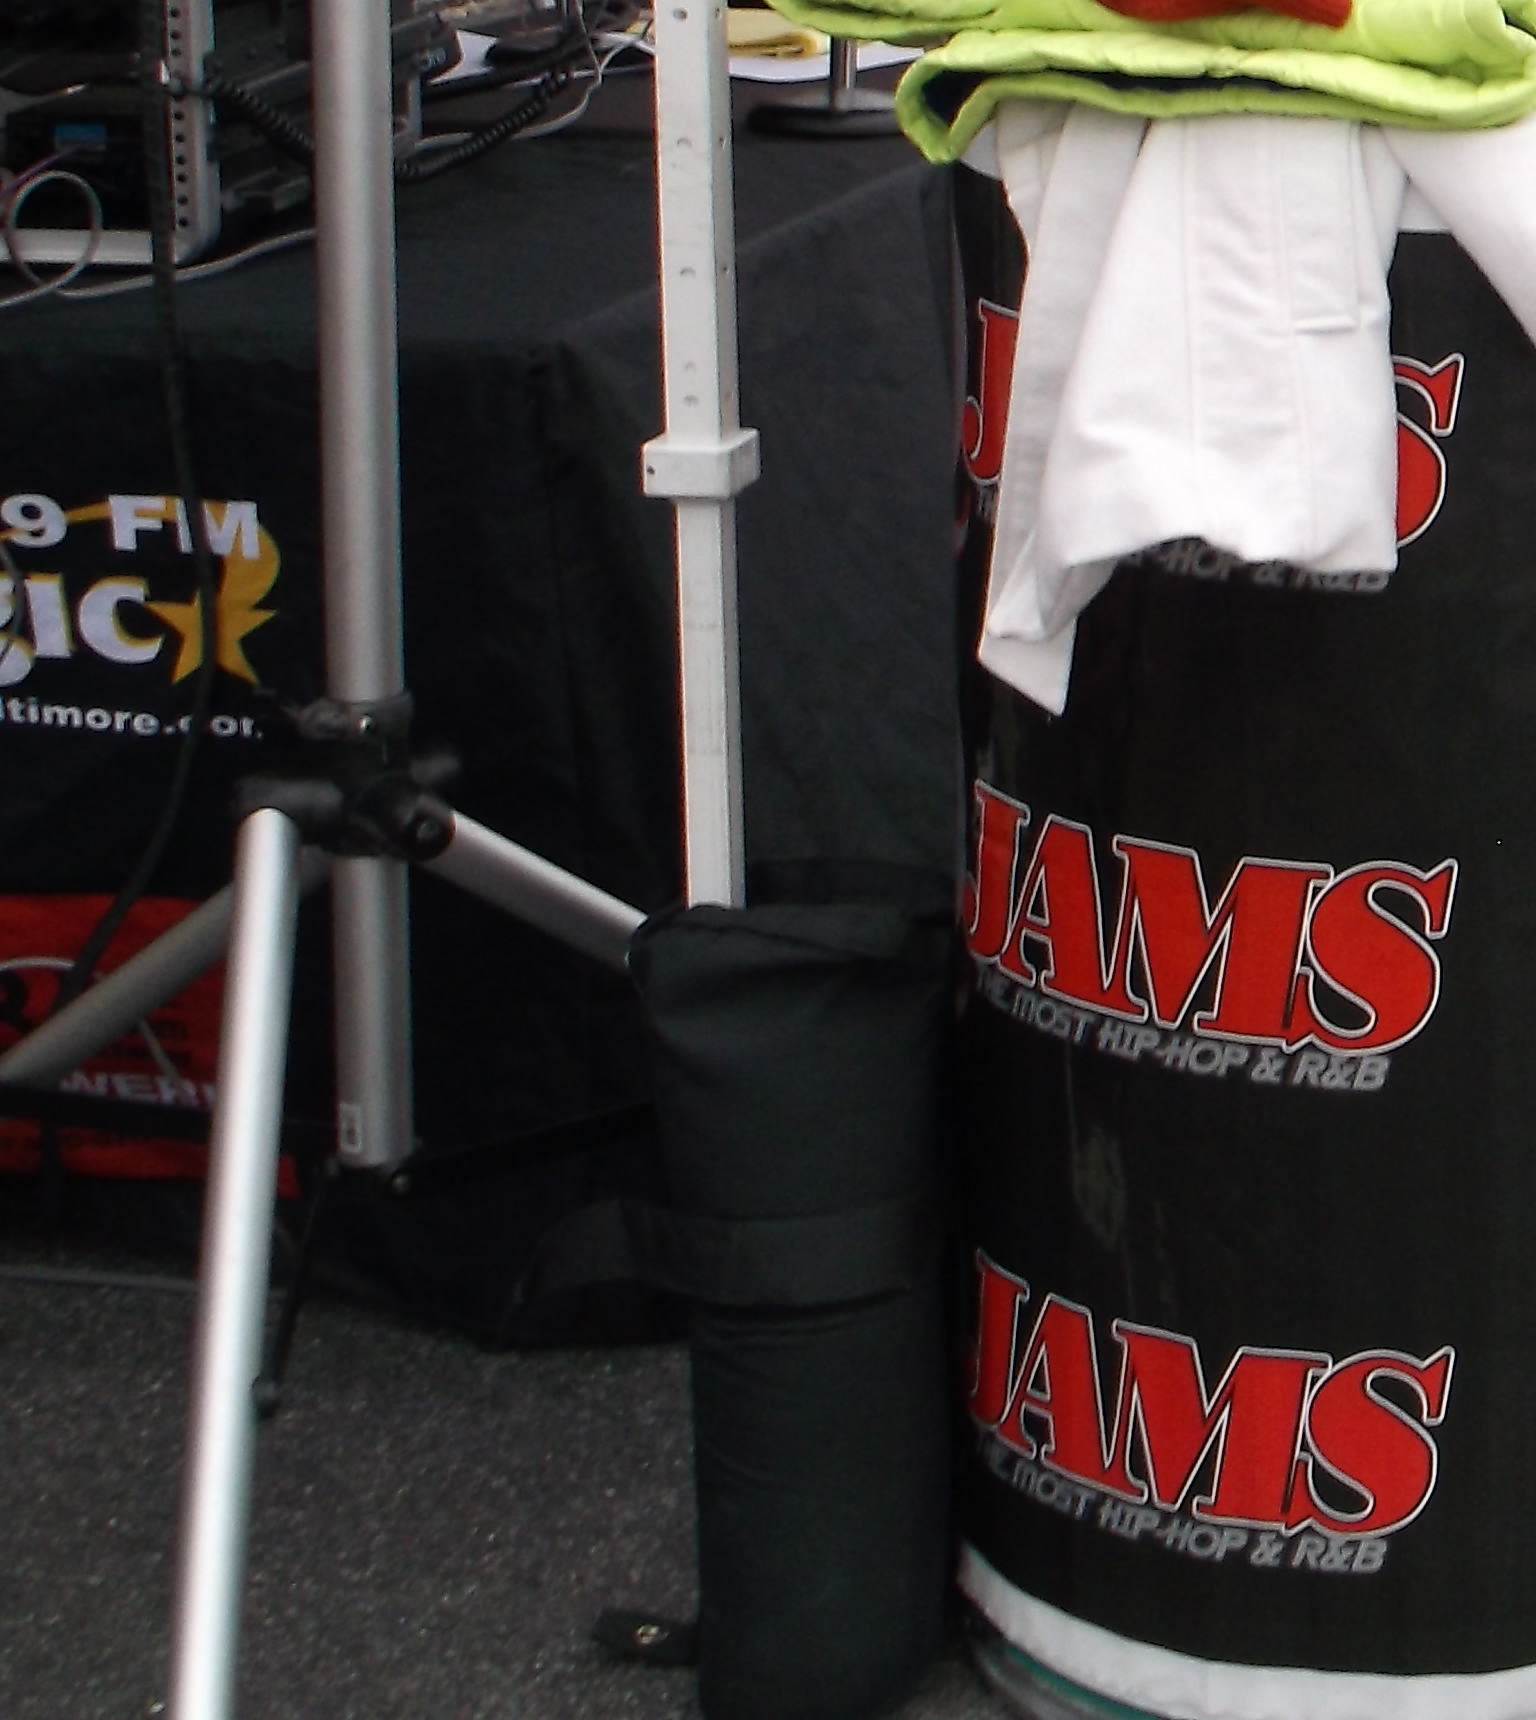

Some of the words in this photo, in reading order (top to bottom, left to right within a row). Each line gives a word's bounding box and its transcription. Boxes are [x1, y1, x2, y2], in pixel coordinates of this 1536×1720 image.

[108, 494, 261, 561] FM
[964, 779, 1459, 1056] JAMS
[1012, 993, 1098, 1045] MOST
[1098, 1019, 1250, 1079] HIP-HOP
[1251, 1048, 1285, 1085] &
[1292, 1050, 1392, 1092] R&B
[967, 1247, 1457, 1537] JAMS
[1012, 1461, 1098, 1520] MOST
[1098, 1494, 1249, 1562] HIP-HOP
[1250, 1531, 1284, 1568] &
[1291, 1531, 1390, 1575] R&B
